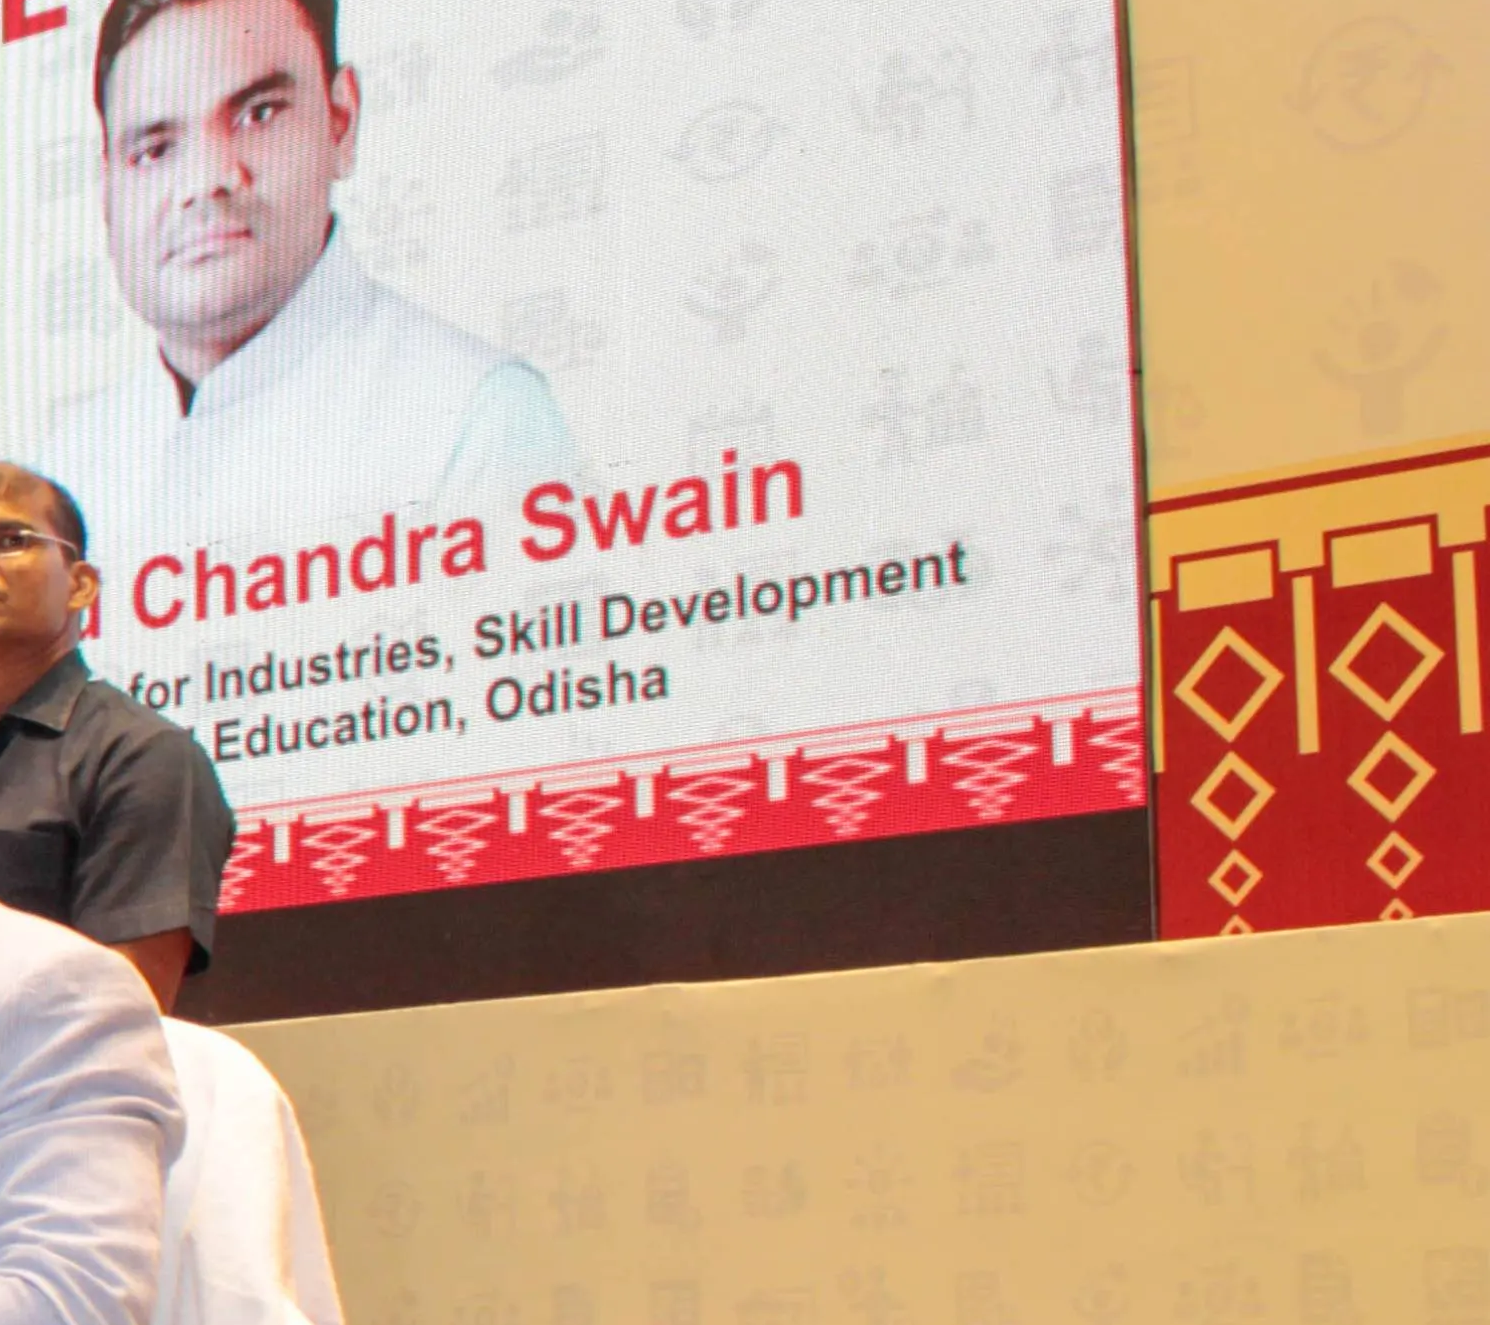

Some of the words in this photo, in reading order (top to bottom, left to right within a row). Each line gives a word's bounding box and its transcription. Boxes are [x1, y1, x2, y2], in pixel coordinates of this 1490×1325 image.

[132, 513, 486, 630] Chandra
[521, 450, 803, 563] Swain
[130, 673, 191, 711] for
[207, 633, 455, 703] Industries,
[475, 601, 581, 660] Skill
[603, 541, 968, 639] Development
[215, 697, 467, 763] Education,
[487, 661, 669, 723] Odisha
